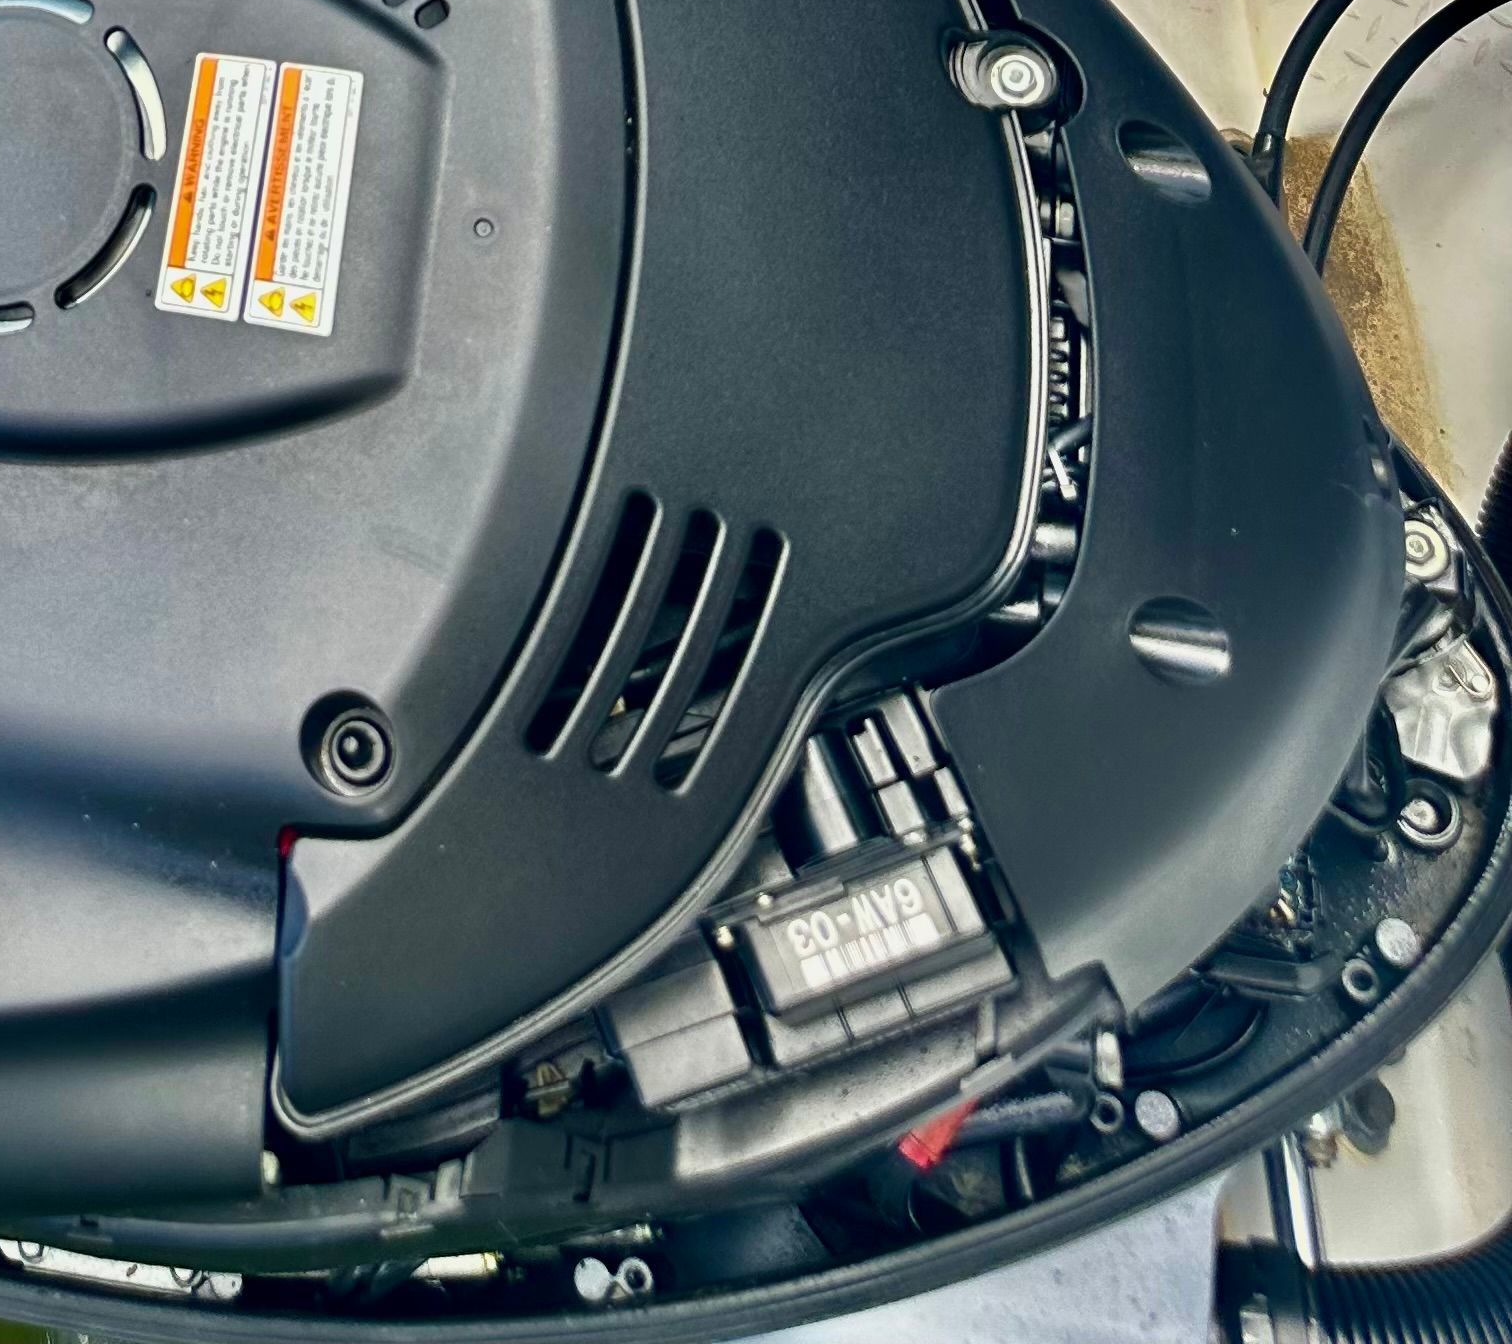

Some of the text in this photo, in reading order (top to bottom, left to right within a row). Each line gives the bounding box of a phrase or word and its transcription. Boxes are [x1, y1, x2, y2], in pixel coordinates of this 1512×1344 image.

[184, 118, 204, 186] WARNING
[266, 104, 293, 224] AVERTISSEMENT
[788, 878, 923, 958] 6AW-03
